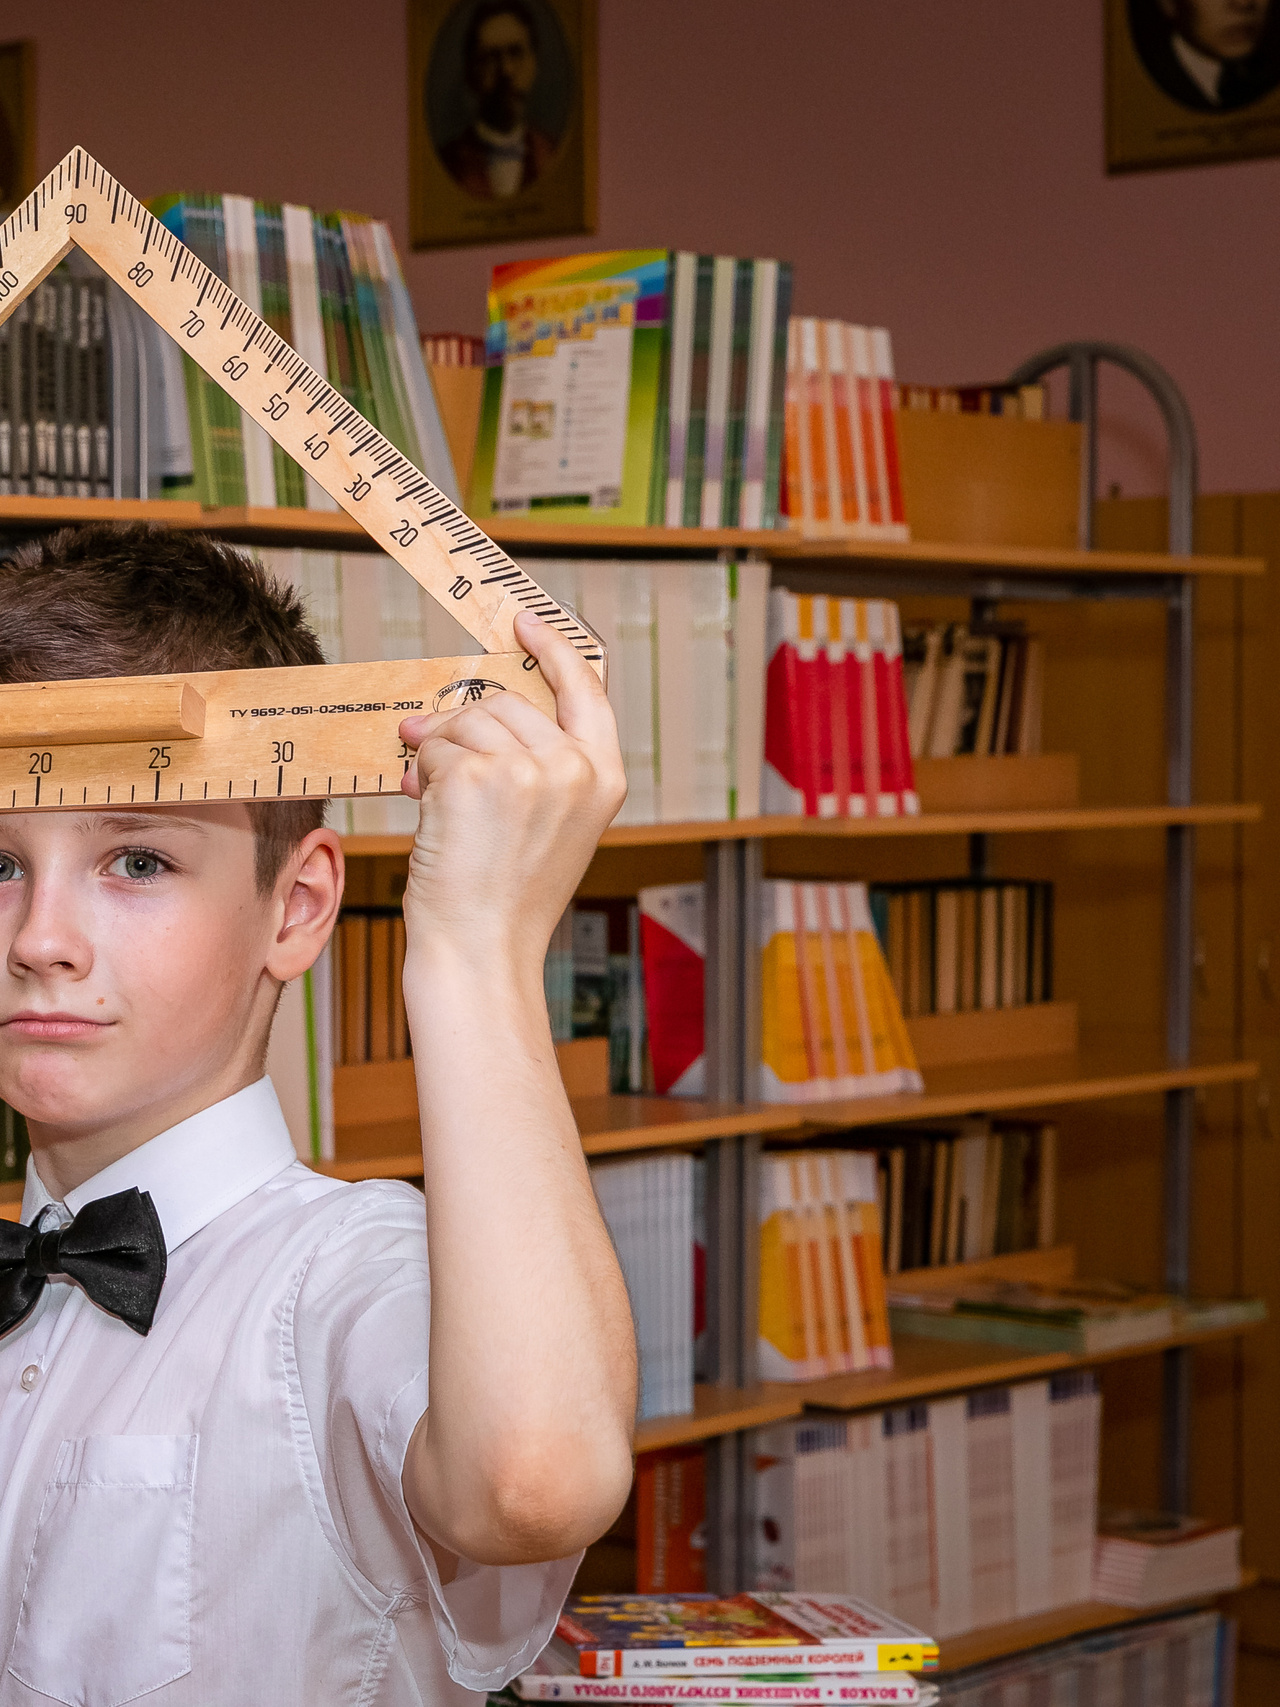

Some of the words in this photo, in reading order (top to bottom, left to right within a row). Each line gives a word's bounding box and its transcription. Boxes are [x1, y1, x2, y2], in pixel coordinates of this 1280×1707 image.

[64, 203, 87, 225] 90
[127, 261, 154, 288] 80
[179, 309, 205, 339] 70
[221, 355, 249, 382] 60
[261, 393, 289, 421] 50
[303, 433, 330, 461] 40
[343, 473, 372, 502] 30
[388, 519, 419, 548] 20
[448, 575, 473, 600] 10
[229, 709, 248, 718] ТУ
[250, 700, 424, 718] 9692-051-02962861-2012
[28, 752, 53, 775] 20
[148, 746, 172, 769] 25
[271, 740, 294, 764] 30
[693, 1657, 725, 1668] СЕМЬ
[728, 1654, 805, 1667] ПОДЗЕМНЫХ
[808, 1651, 865, 1666] КОРОЛЕЙ
[573, 1684, 626, 1698] ГОРОДА
[735, 1686, 821, 1701] ВОЛШЕБНИК
[840, 1686, 898, 1701] ВОЛКОВ
